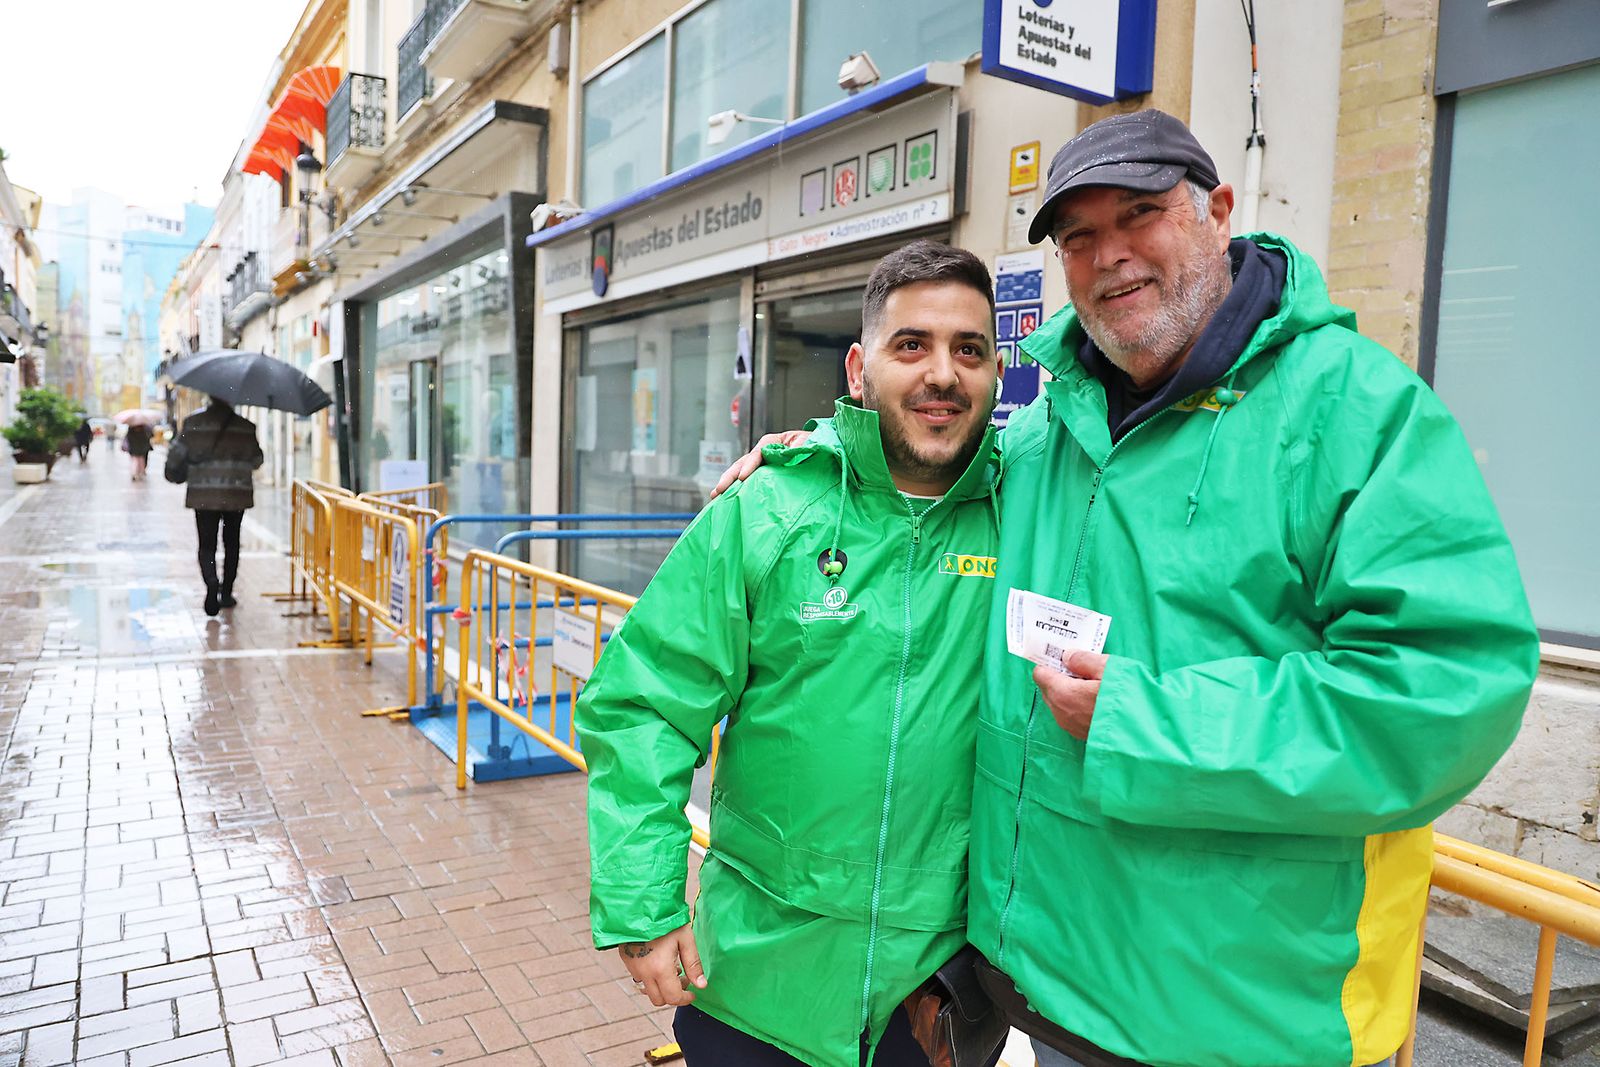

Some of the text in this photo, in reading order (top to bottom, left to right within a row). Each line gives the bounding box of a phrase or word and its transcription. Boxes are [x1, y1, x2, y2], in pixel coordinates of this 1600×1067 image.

[1019, 5, 1075, 40] Loterías y
[1017, 43, 1057, 67] Estado
[1018, 25, 1091, 61] Apuestas del
[614, 225, 673, 268] Apuestas
[677, 208, 700, 244] del
[703, 190, 762, 235] Estado
[834, 209, 908, 239] Administración
[931, 200, 938, 216] 2
